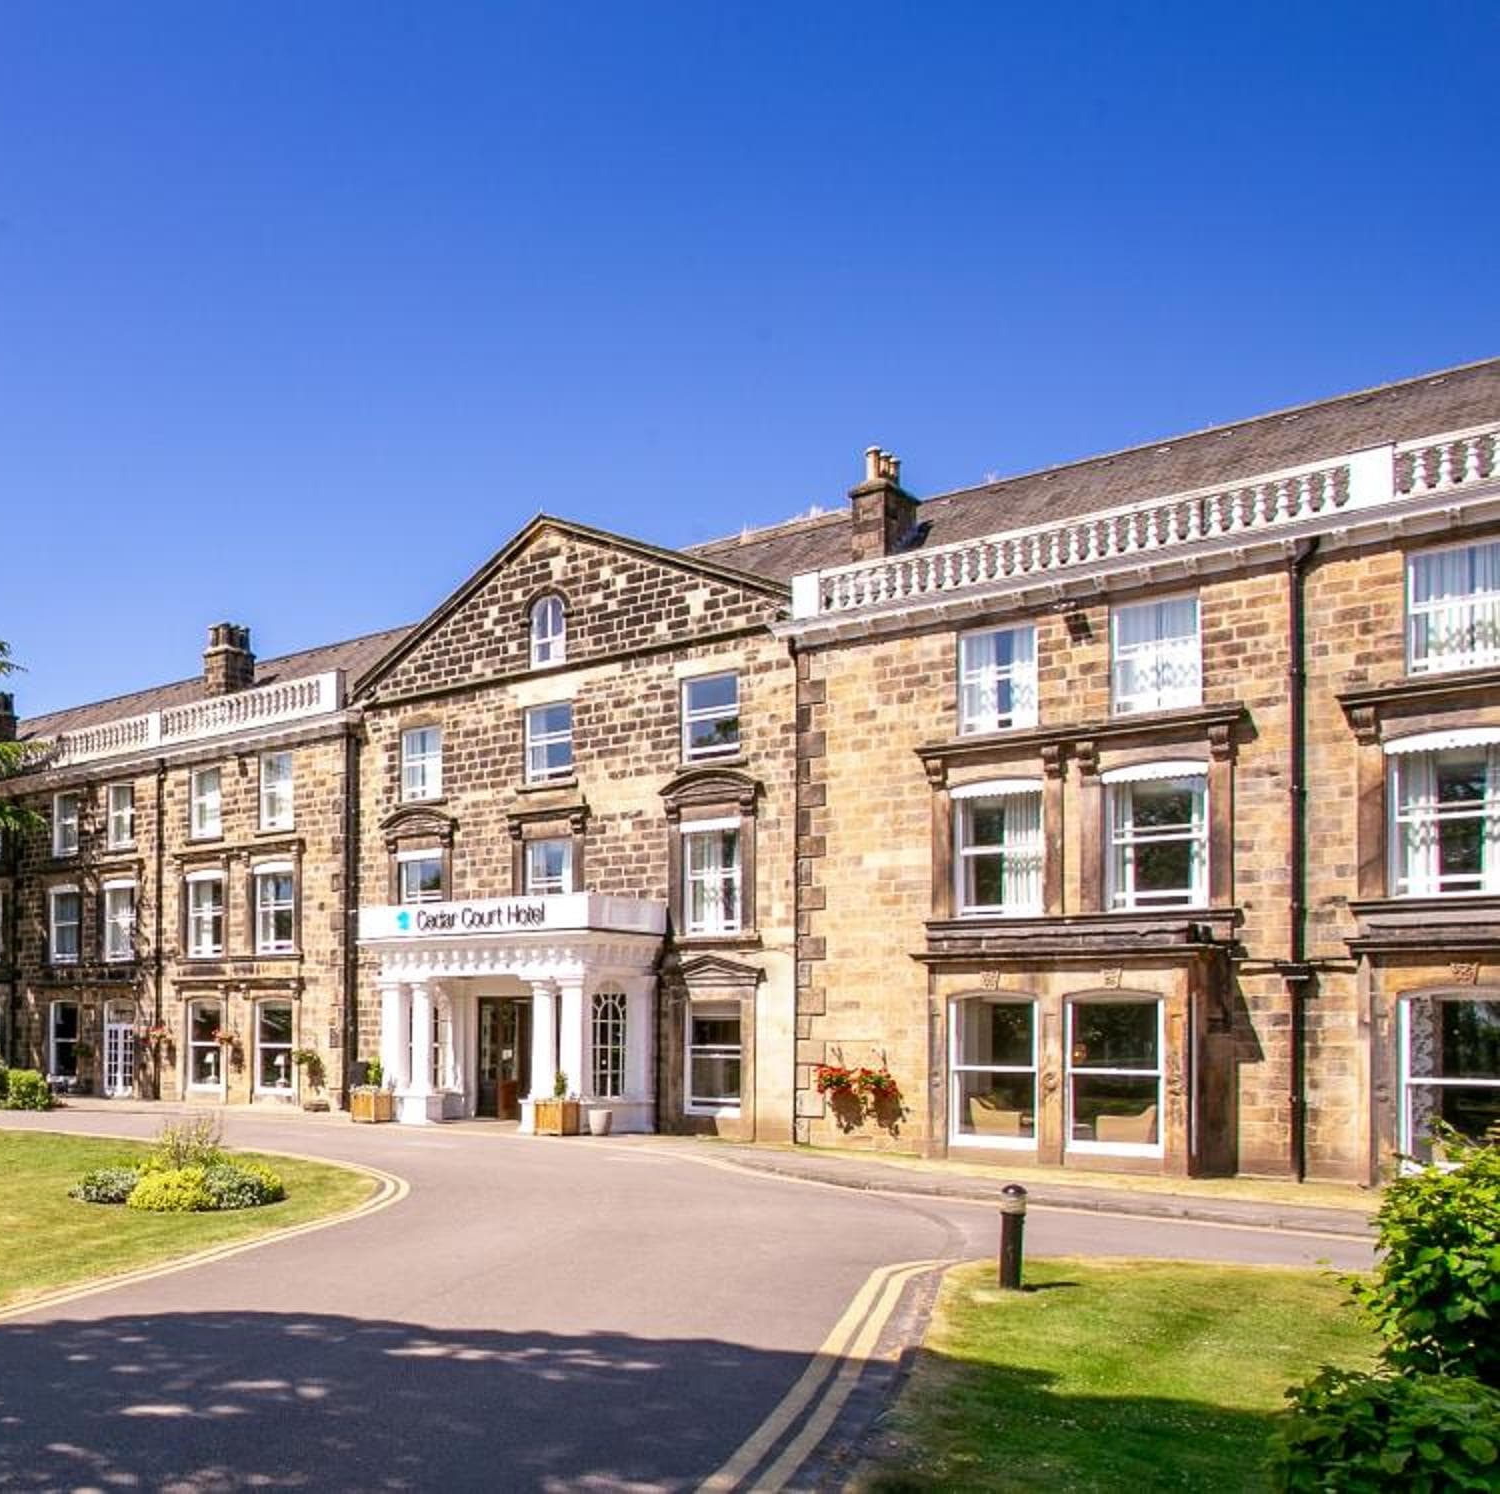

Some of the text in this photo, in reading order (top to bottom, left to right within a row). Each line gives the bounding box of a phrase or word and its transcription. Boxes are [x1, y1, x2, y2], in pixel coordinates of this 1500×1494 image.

[416, 903, 545, 930] Cedar Court Hotel
